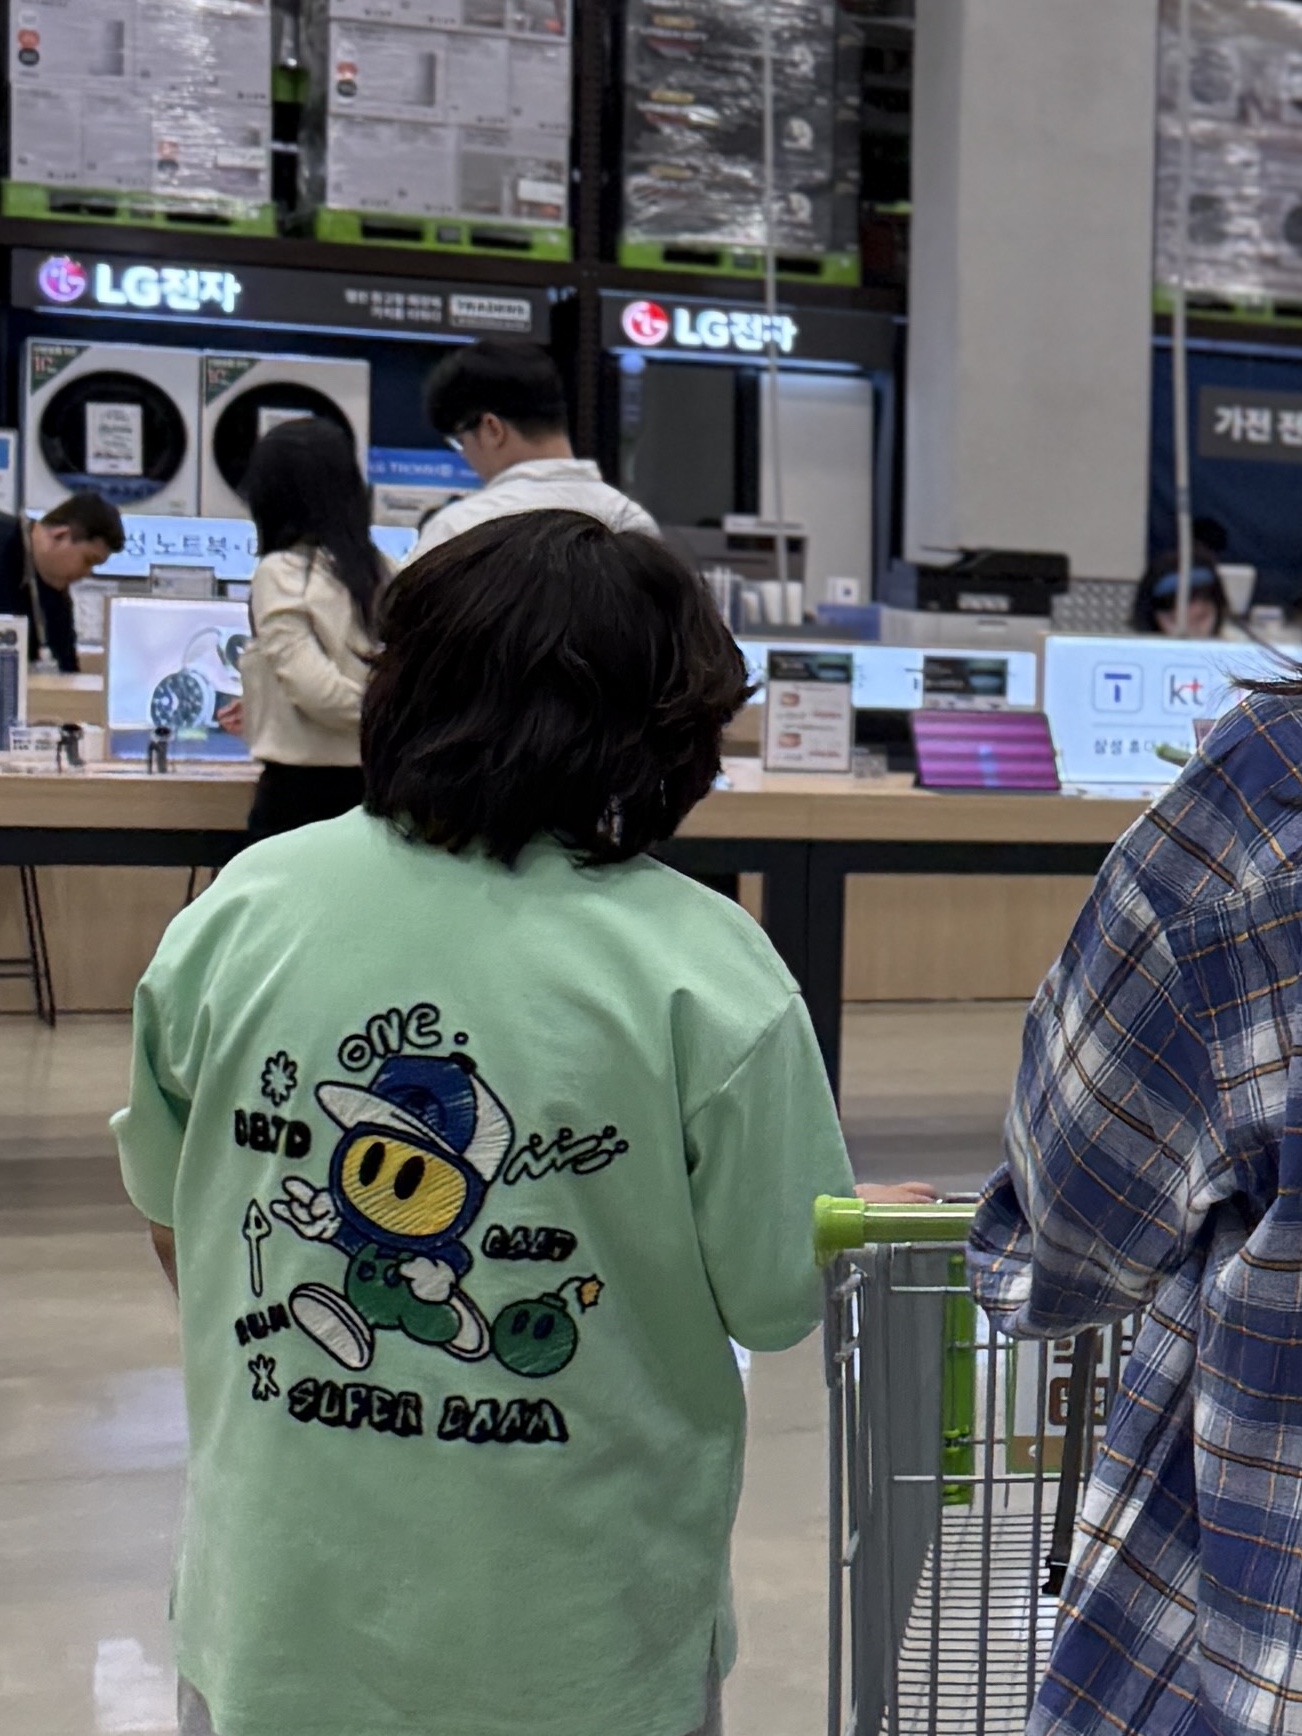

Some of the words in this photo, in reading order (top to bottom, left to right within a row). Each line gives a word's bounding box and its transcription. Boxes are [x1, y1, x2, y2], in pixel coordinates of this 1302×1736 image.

[96, 258, 242, 313] LG전자
[673, 307, 798, 353] LG전자
[1214, 405, 1272, 443] 가전
[157, 531, 228, 562] 노트북
[1169, 674, 1204, 706] kt
